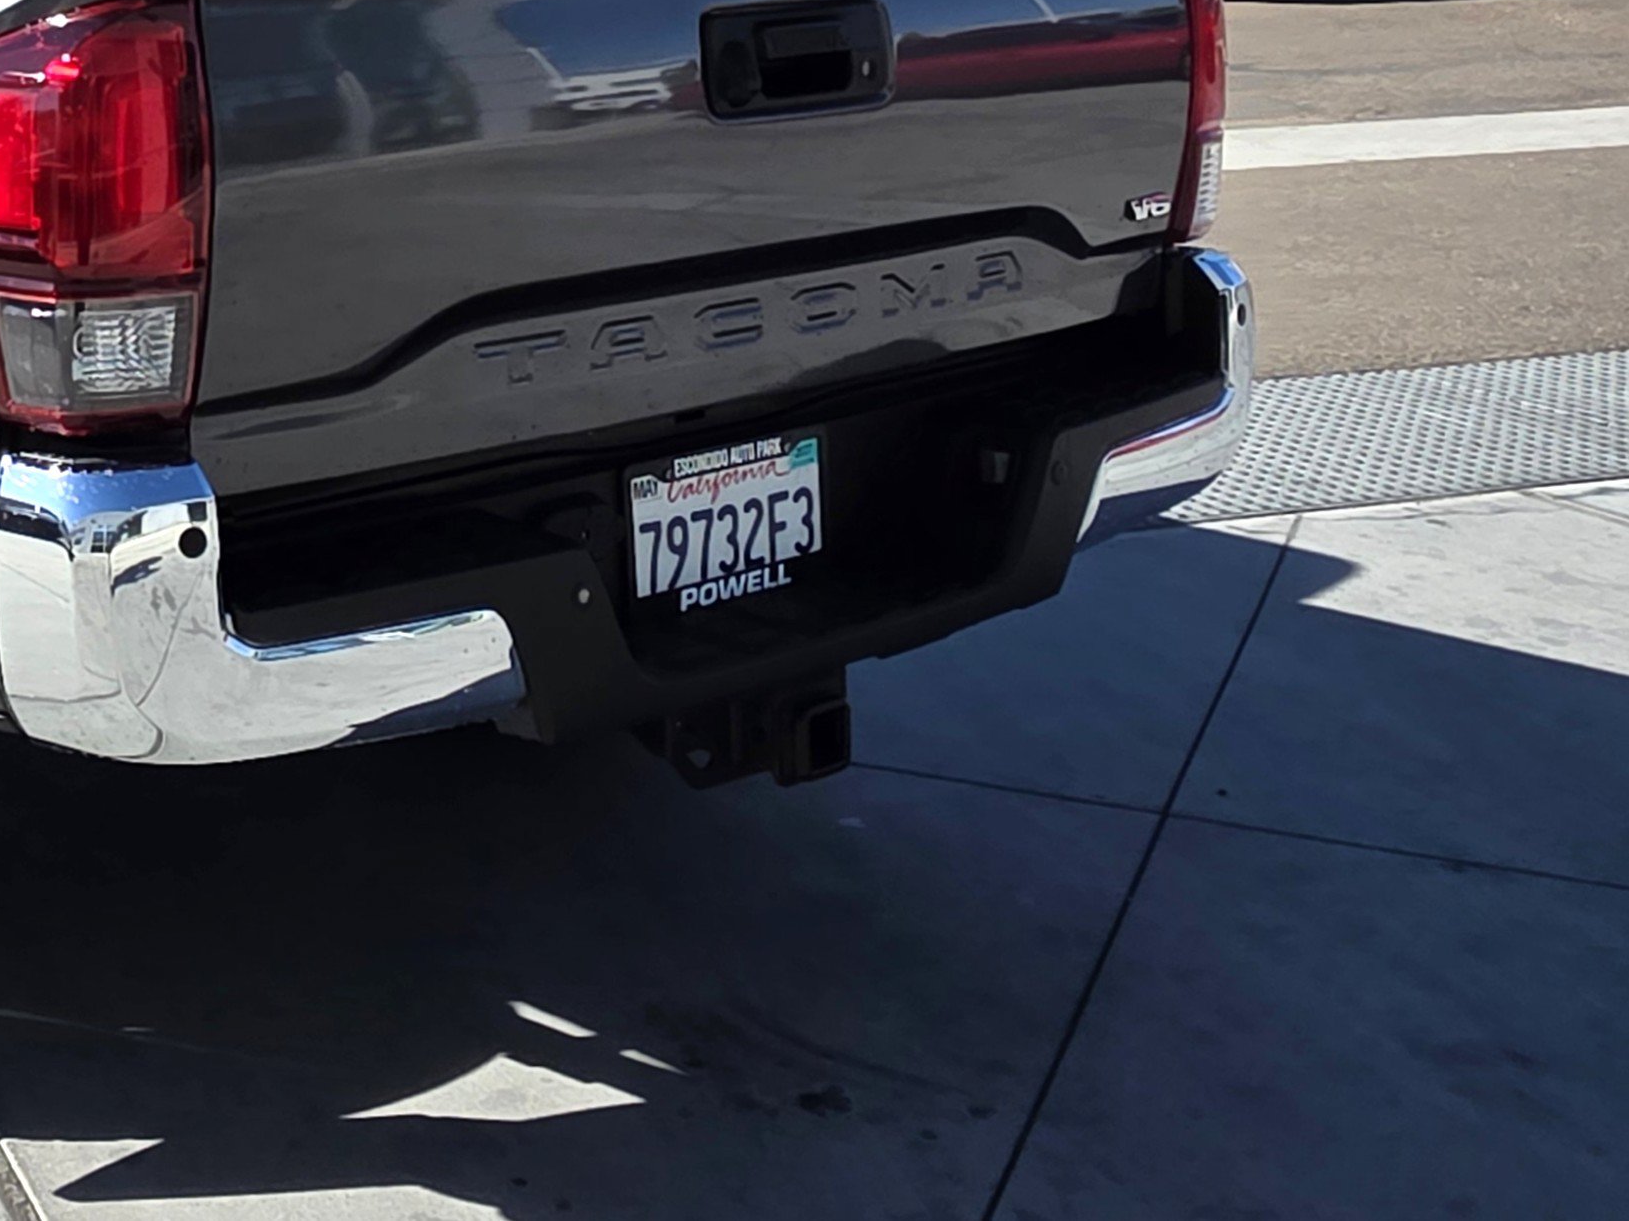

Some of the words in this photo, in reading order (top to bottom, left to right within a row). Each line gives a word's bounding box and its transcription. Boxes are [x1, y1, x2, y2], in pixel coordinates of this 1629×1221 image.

[1130, 196, 1172, 221] V6
[472, 250, 1023, 385] TACOMA
[730, 442, 756, 464] AUTO
[756, 437, 782, 459] PARK
[633, 478, 659, 500] MAY
[666, 460, 792, 504] California
[639, 485, 815, 594] 79732F3
[680, 563, 792, 612] POWELL
